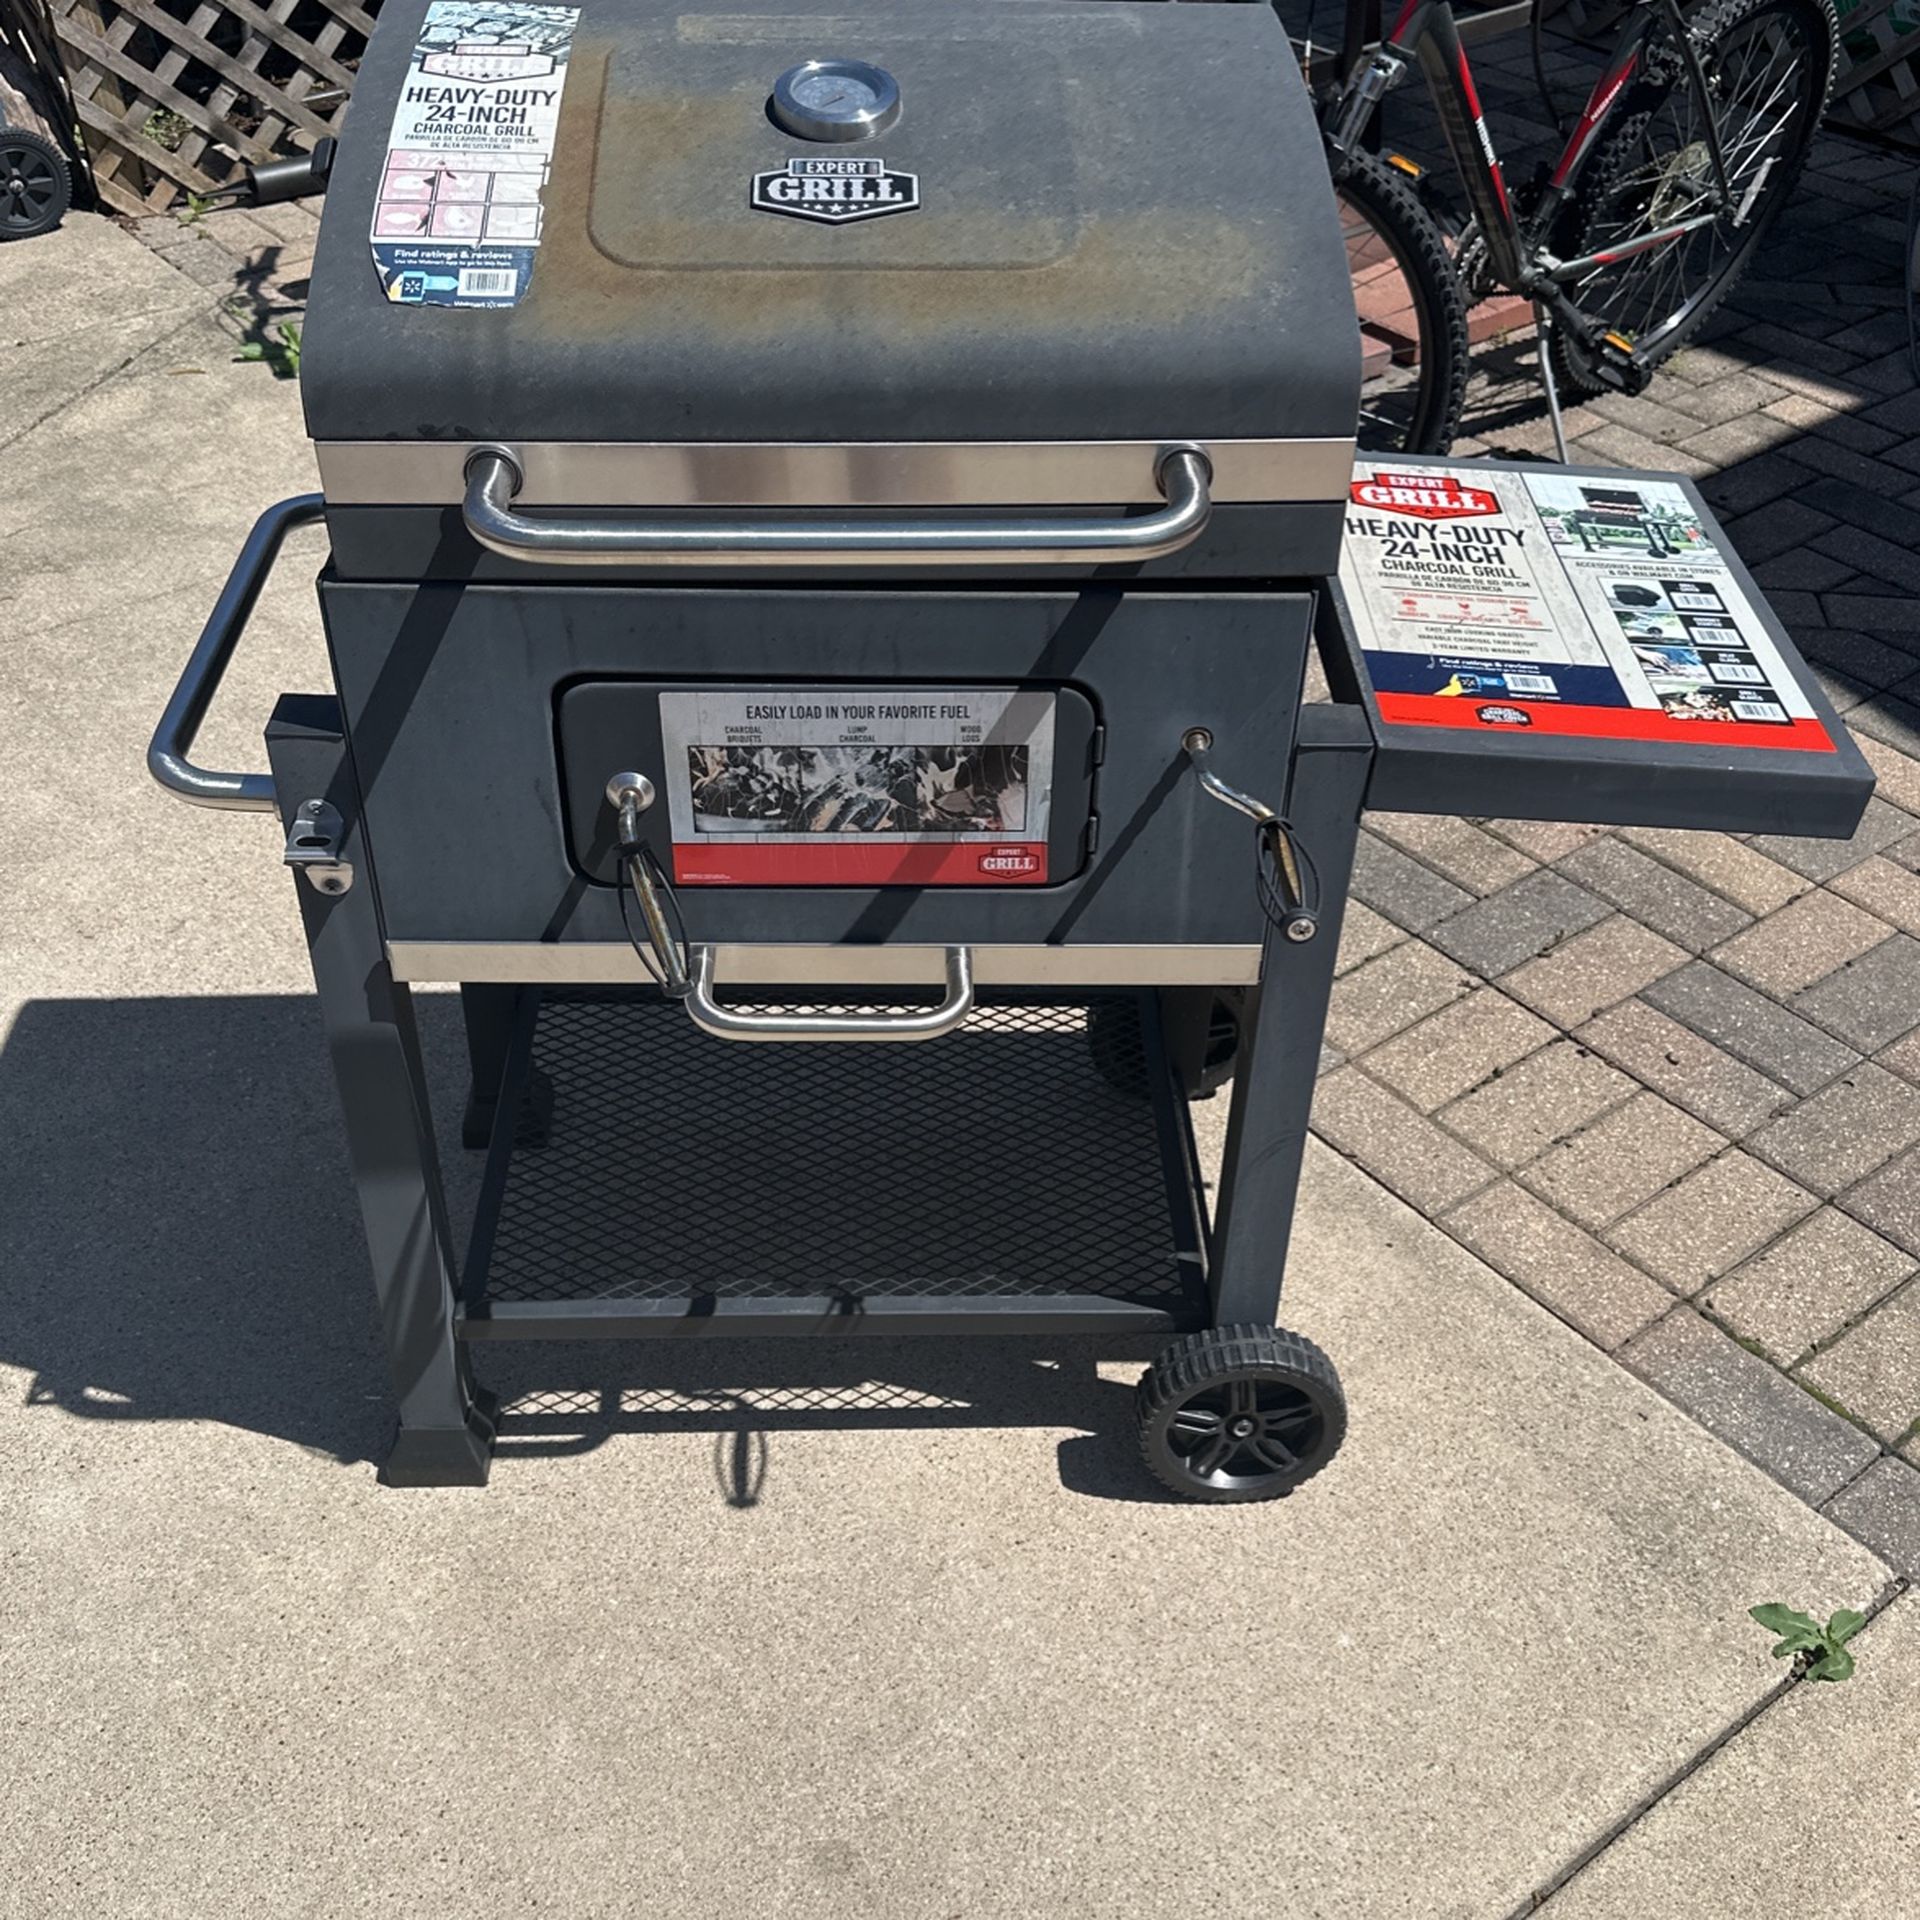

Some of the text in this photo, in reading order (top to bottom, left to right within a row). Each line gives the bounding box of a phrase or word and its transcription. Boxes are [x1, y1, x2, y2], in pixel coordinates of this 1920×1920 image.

[406, 87, 556, 106] HEAVY-DUTY
[425, 104, 527, 124] 24-INCH
[413, 122, 535, 137] CHARCOAL GRILL
[806, 162, 866, 174] EXPERT
[766, 178, 903, 201] GRILL
[394, 249, 513, 260] Find ratings & reviews
[1389, 476, 1444, 489] EXPERT
[1359, 486, 1487, 511] GRILL
[1346, 517, 1524, 547] HEAVY-DUTY
[1381, 539, 1506, 565] 24-INCH
[1381, 559, 1521, 579] CHARCOAL GRILL
[1424, 581, 1444, 589] ALTA
[746, 705, 970, 719] EASILY LOAD IN YOUR FAVORITE FUEL
[724, 726, 763, 734] CHARCOAL
[847, 726, 868, 734] LUMP
[839, 735, 876, 743] CHARCOAL
[982, 856, 1034, 870] GRILL
